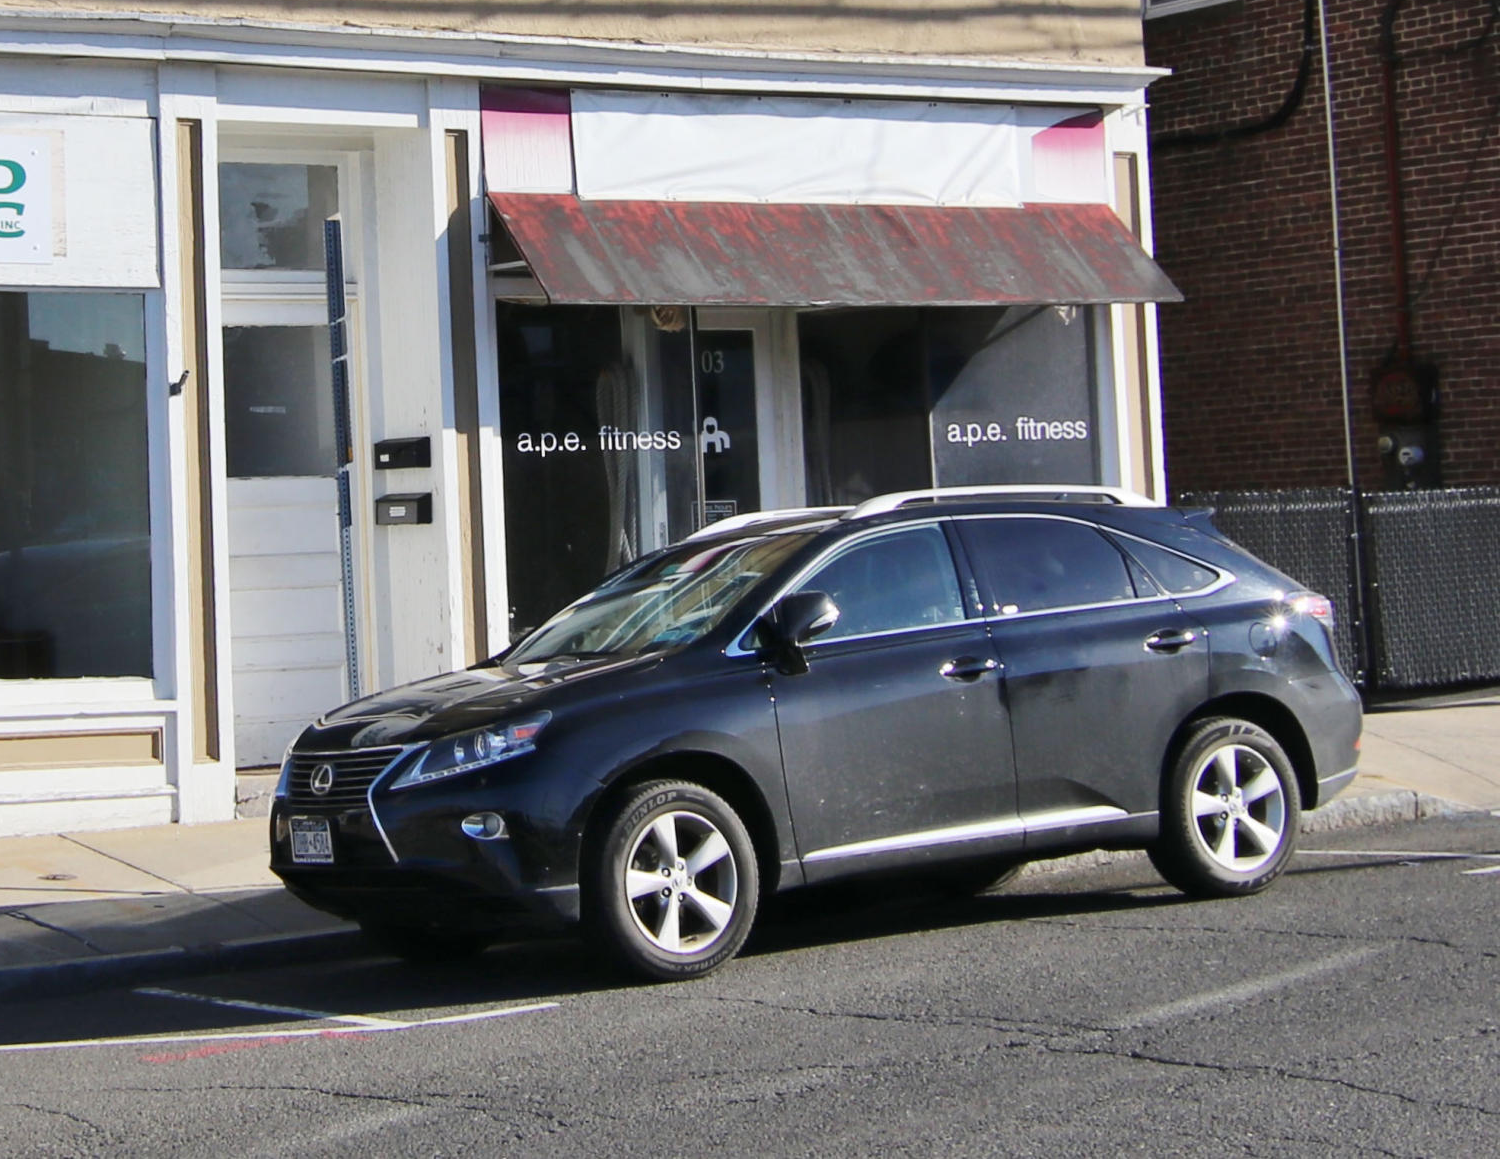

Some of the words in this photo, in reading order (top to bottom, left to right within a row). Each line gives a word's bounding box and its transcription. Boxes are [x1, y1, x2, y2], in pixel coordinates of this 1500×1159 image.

[0, 220, 21, 230] INC
[517, 432, 587, 457] a.p.e.
[598, 425, 682, 451] fitness
[947, 422, 1008, 447] a.p.e.
[1015, 416, 1088, 441] fitness
[624, 791, 677, 835] DUNLOP
